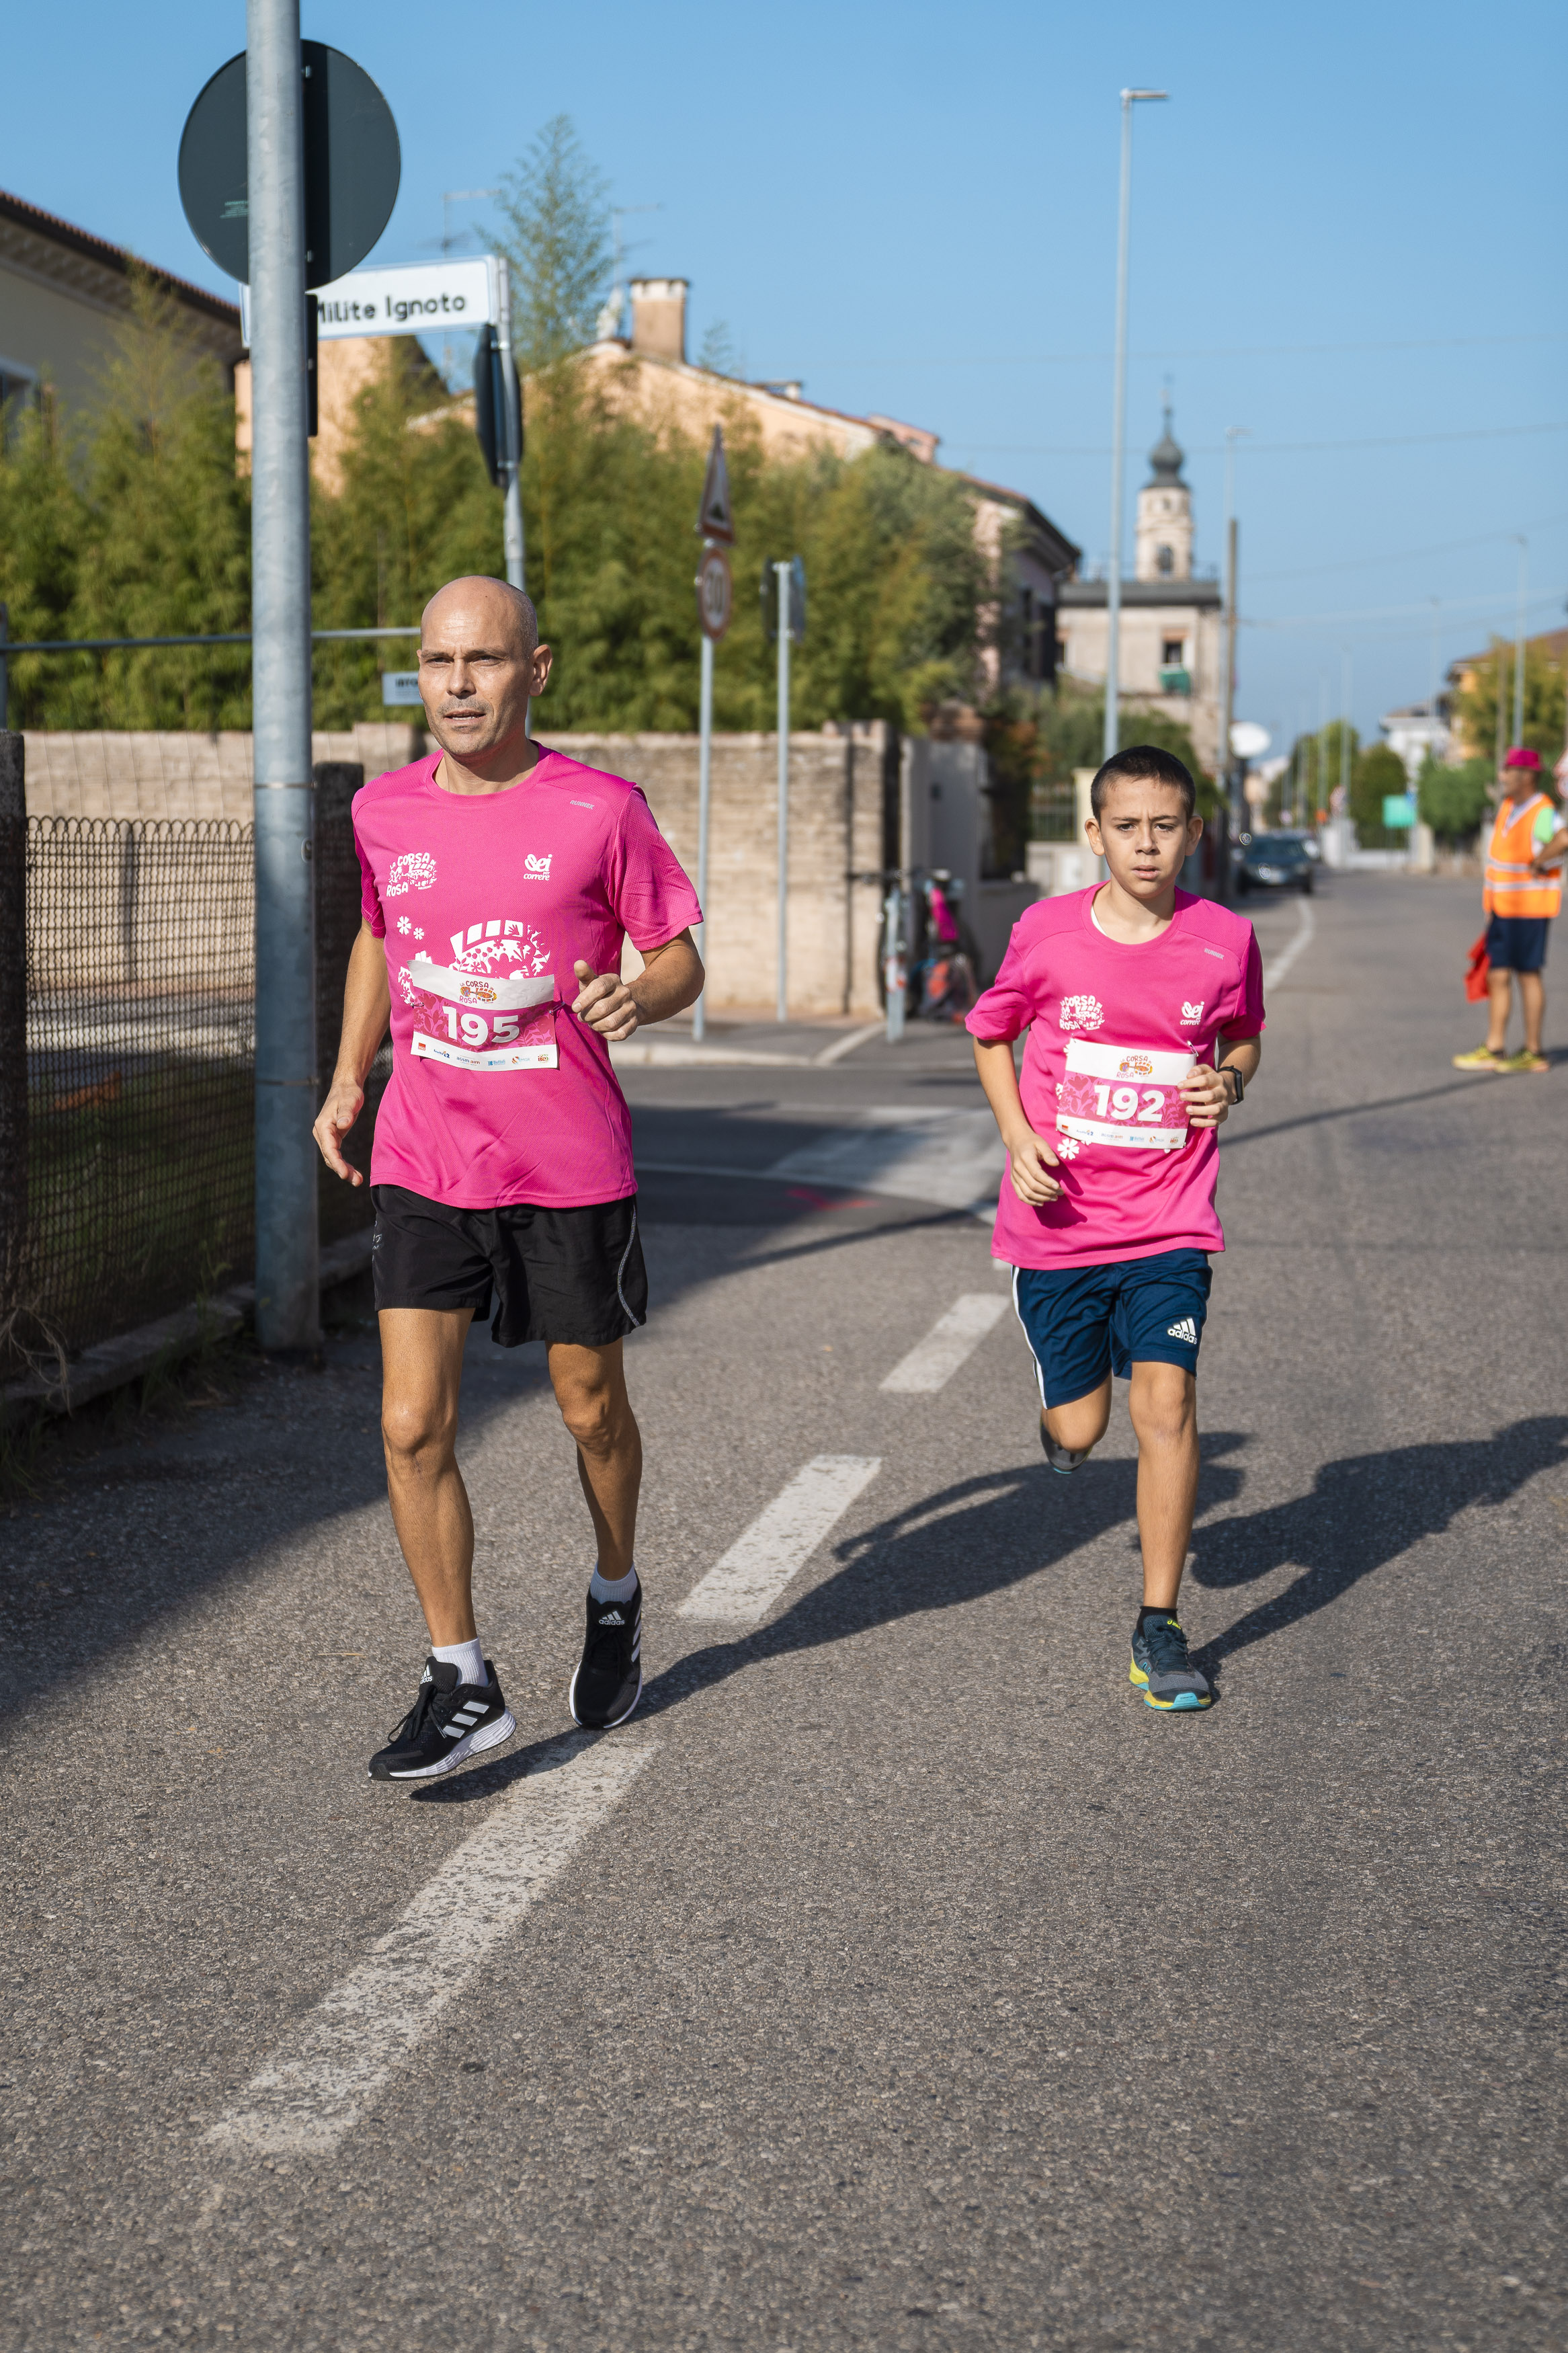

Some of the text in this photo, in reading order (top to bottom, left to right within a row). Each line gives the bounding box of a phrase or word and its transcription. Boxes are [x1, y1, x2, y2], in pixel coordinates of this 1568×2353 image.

[385, 294, 466, 321] Ignoto
[397, 852, 430, 867] CORSA
[386, 881, 409, 897] ROSA
[466, 981, 489, 989] CORSA
[459, 995, 477, 1004] ROSA
[1064, 995, 1096, 1007] CORSA
[442, 1006, 520, 1047] 195
[1059, 1019, 1081, 1031] ROSA
[1094, 1085, 1165, 1122] 192
[1167, 1328, 1198, 1345] adidas
